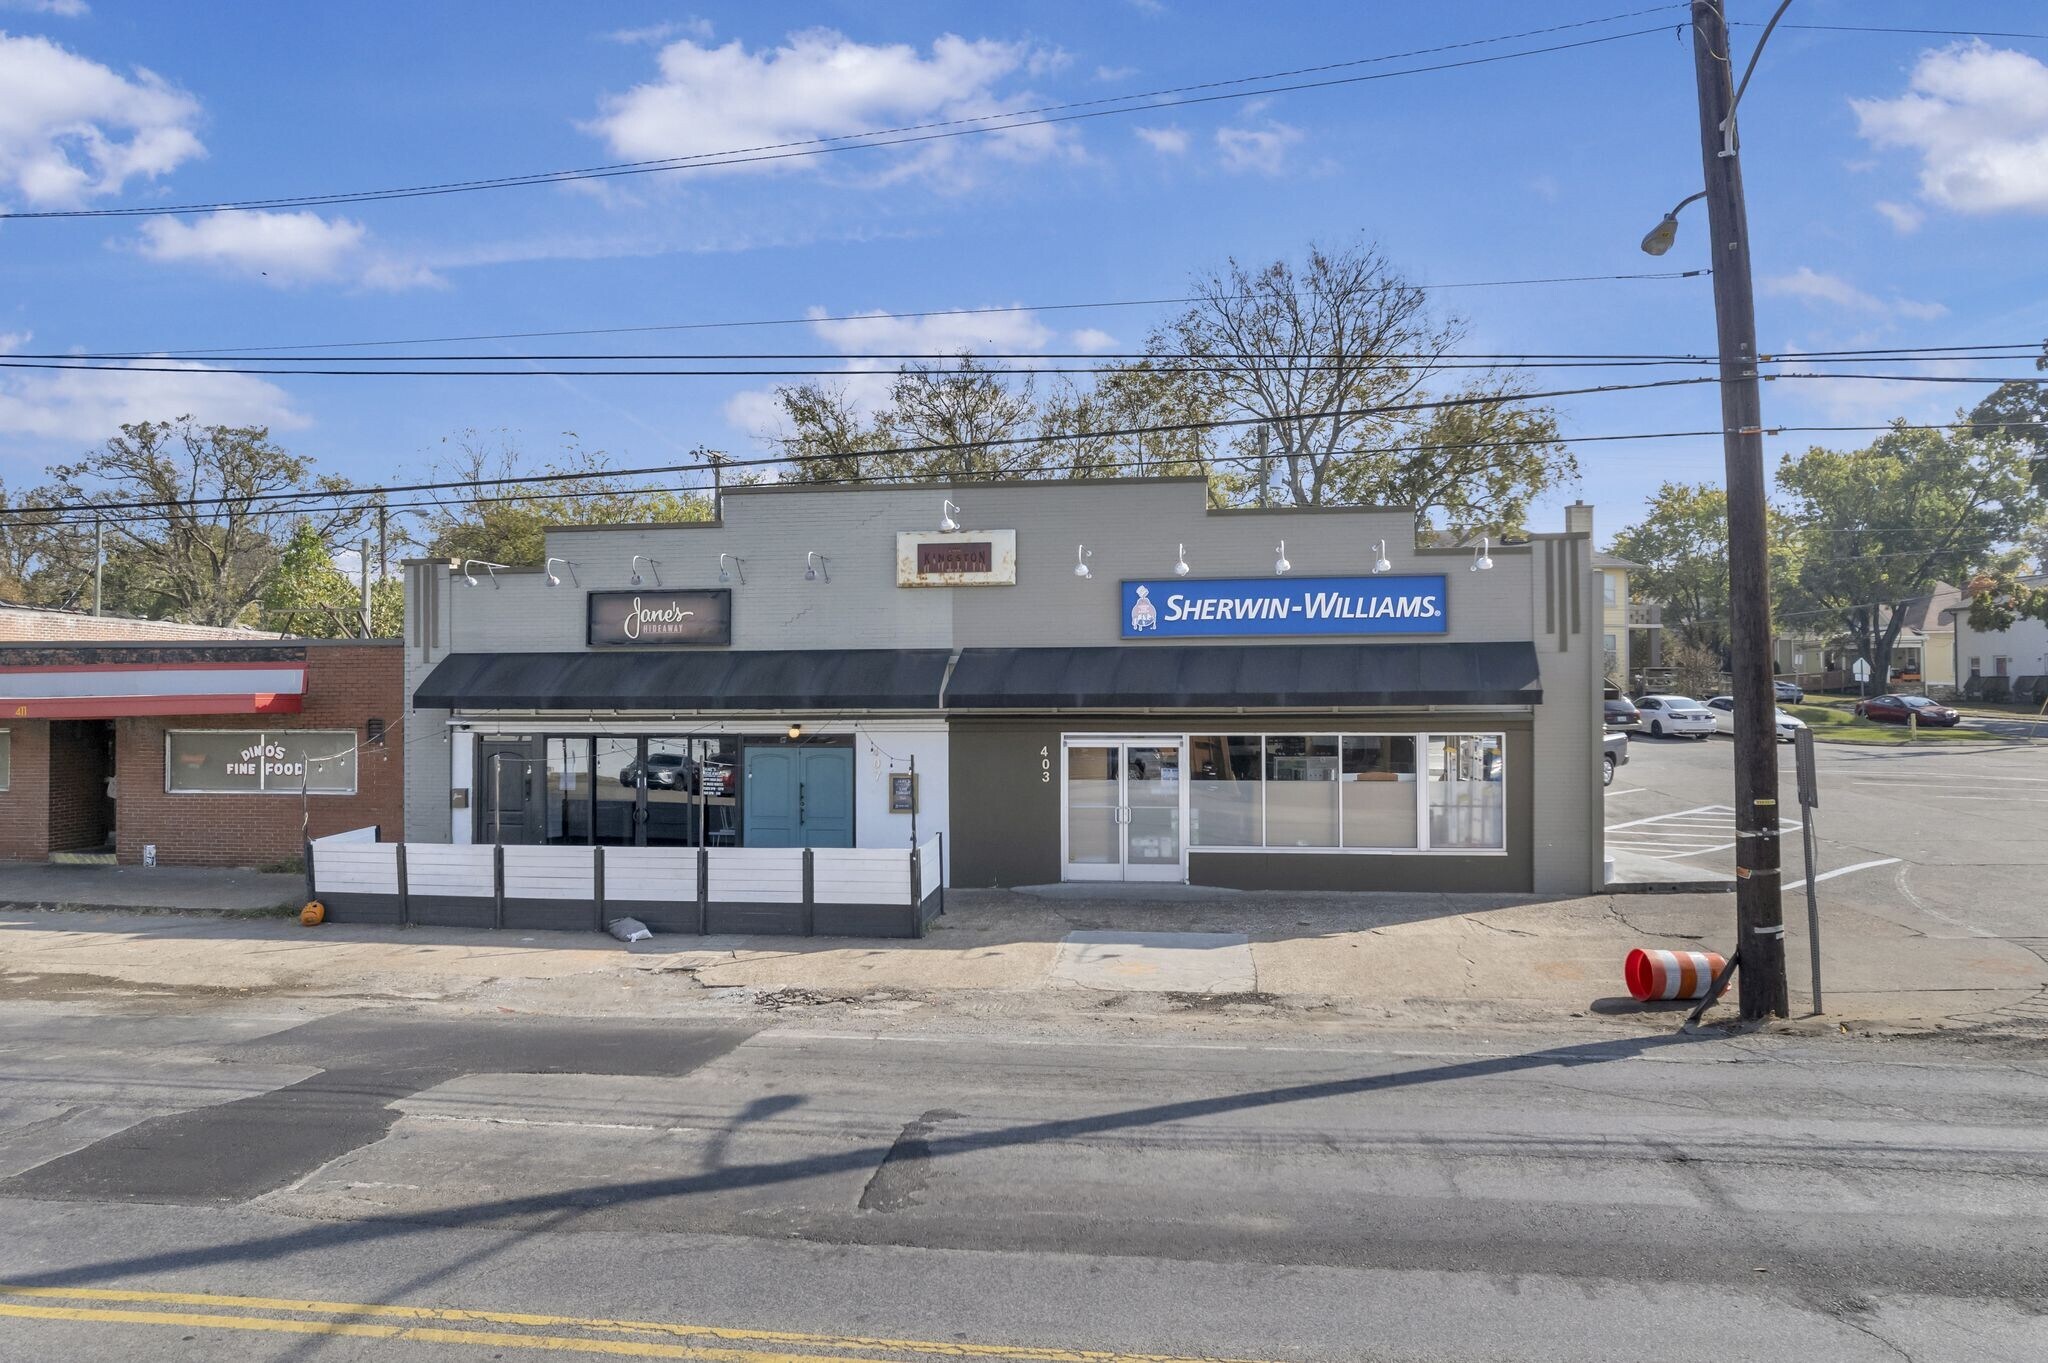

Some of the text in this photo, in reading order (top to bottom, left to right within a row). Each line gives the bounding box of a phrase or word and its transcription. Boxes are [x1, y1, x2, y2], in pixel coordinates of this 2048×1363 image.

[624, 597, 694, 639] Jane's
[643, 625, 683, 633] HIDEAWAY
[16, 705, 27, 717] 411
[241, 741, 286, 761] DINO'S
[226, 762, 303, 776] FINE FOOD
[1040, 745, 1050, 782] 403
